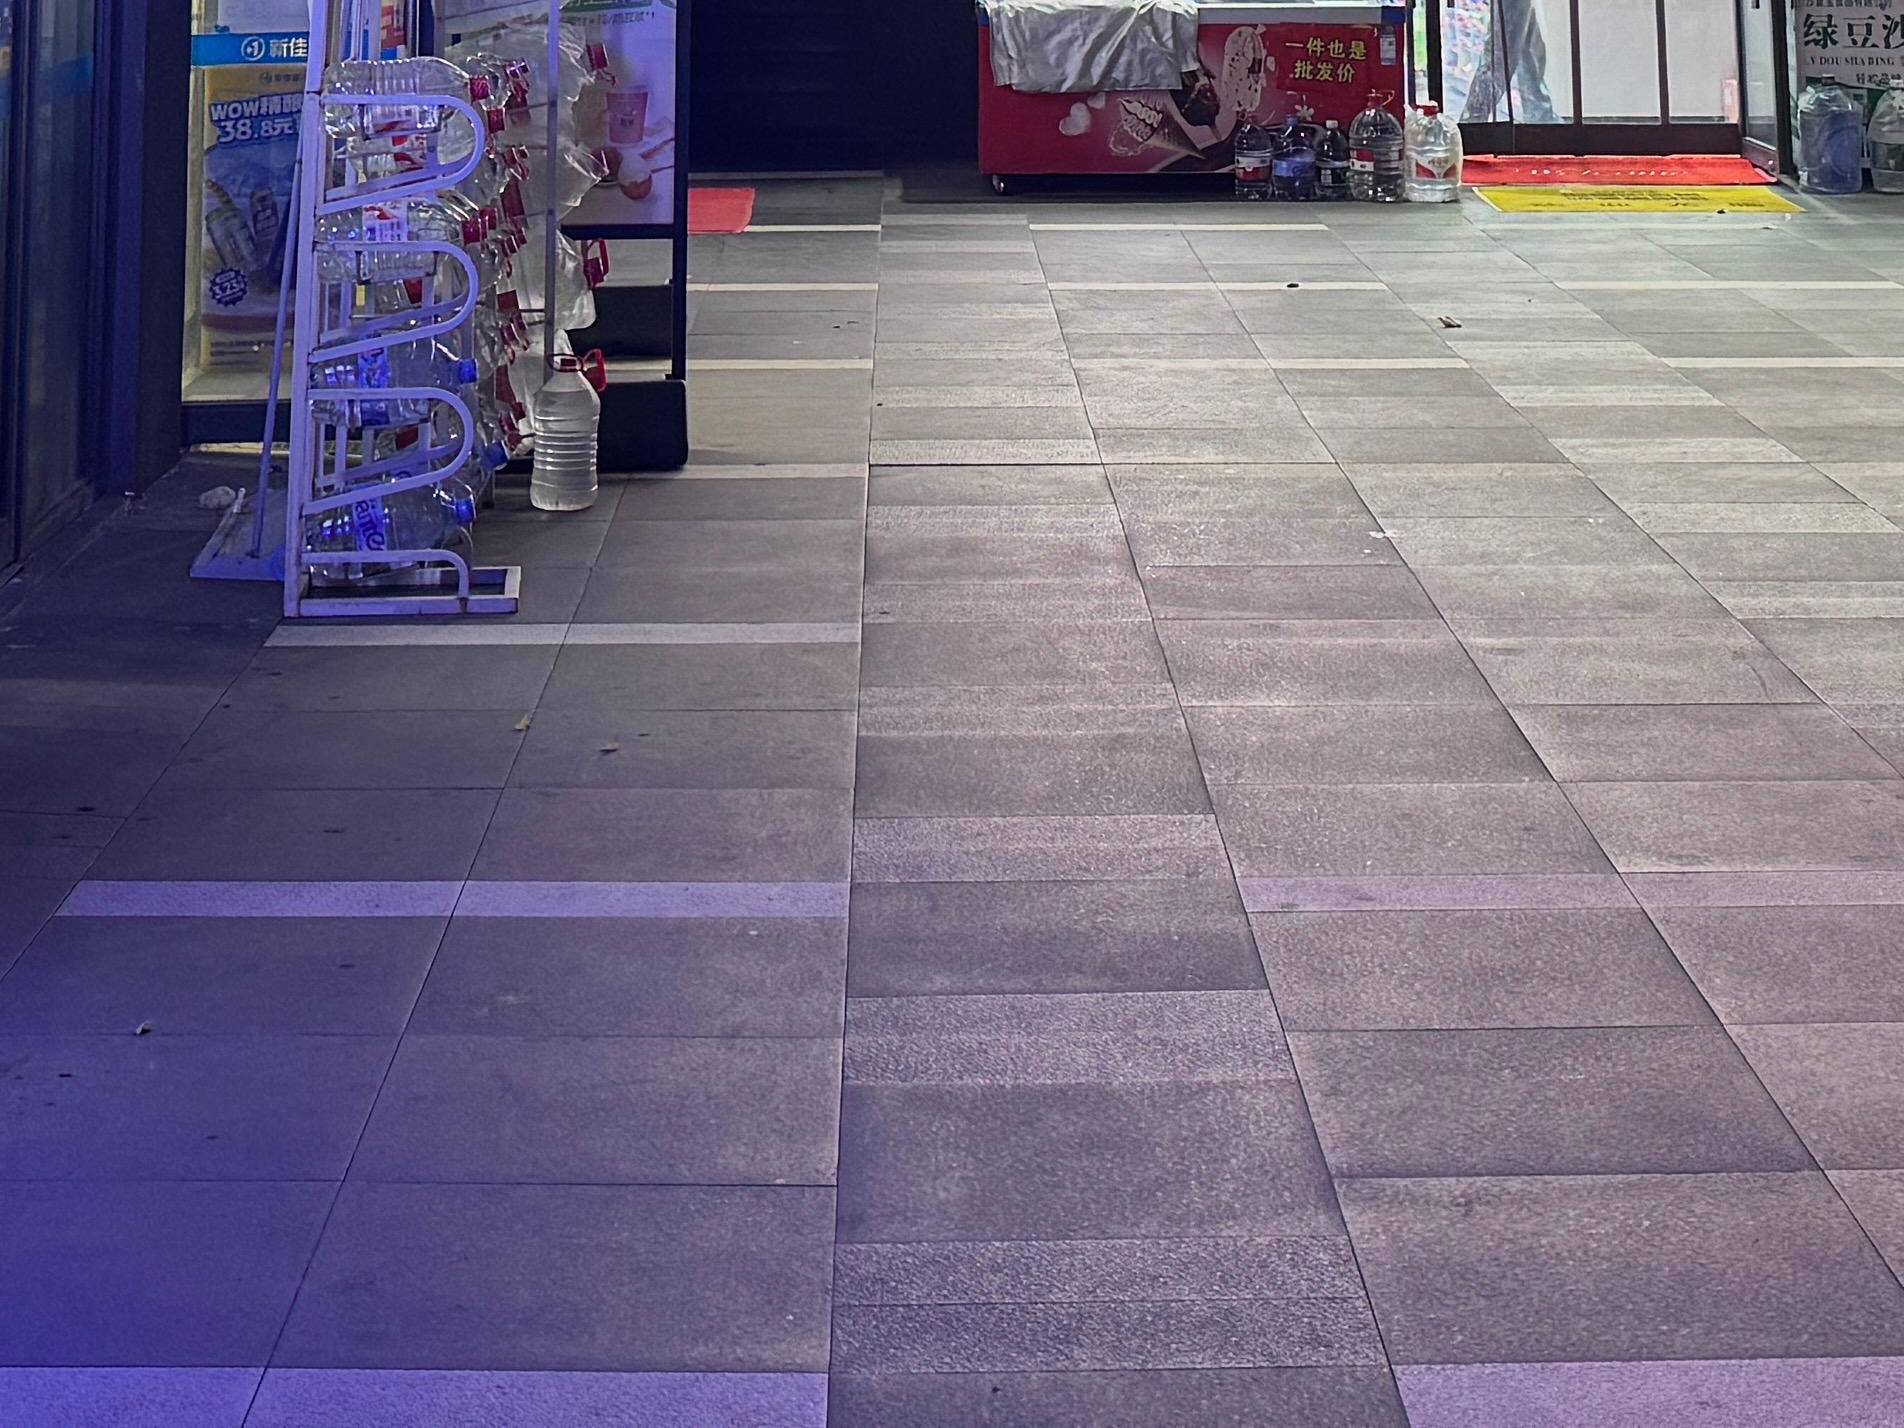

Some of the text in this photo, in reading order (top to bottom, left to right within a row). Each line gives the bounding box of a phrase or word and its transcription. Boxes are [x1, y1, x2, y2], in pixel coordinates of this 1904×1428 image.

[1285, 37, 1368, 61] 一件也是
[1294, 60, 1356, 84] 批发价
